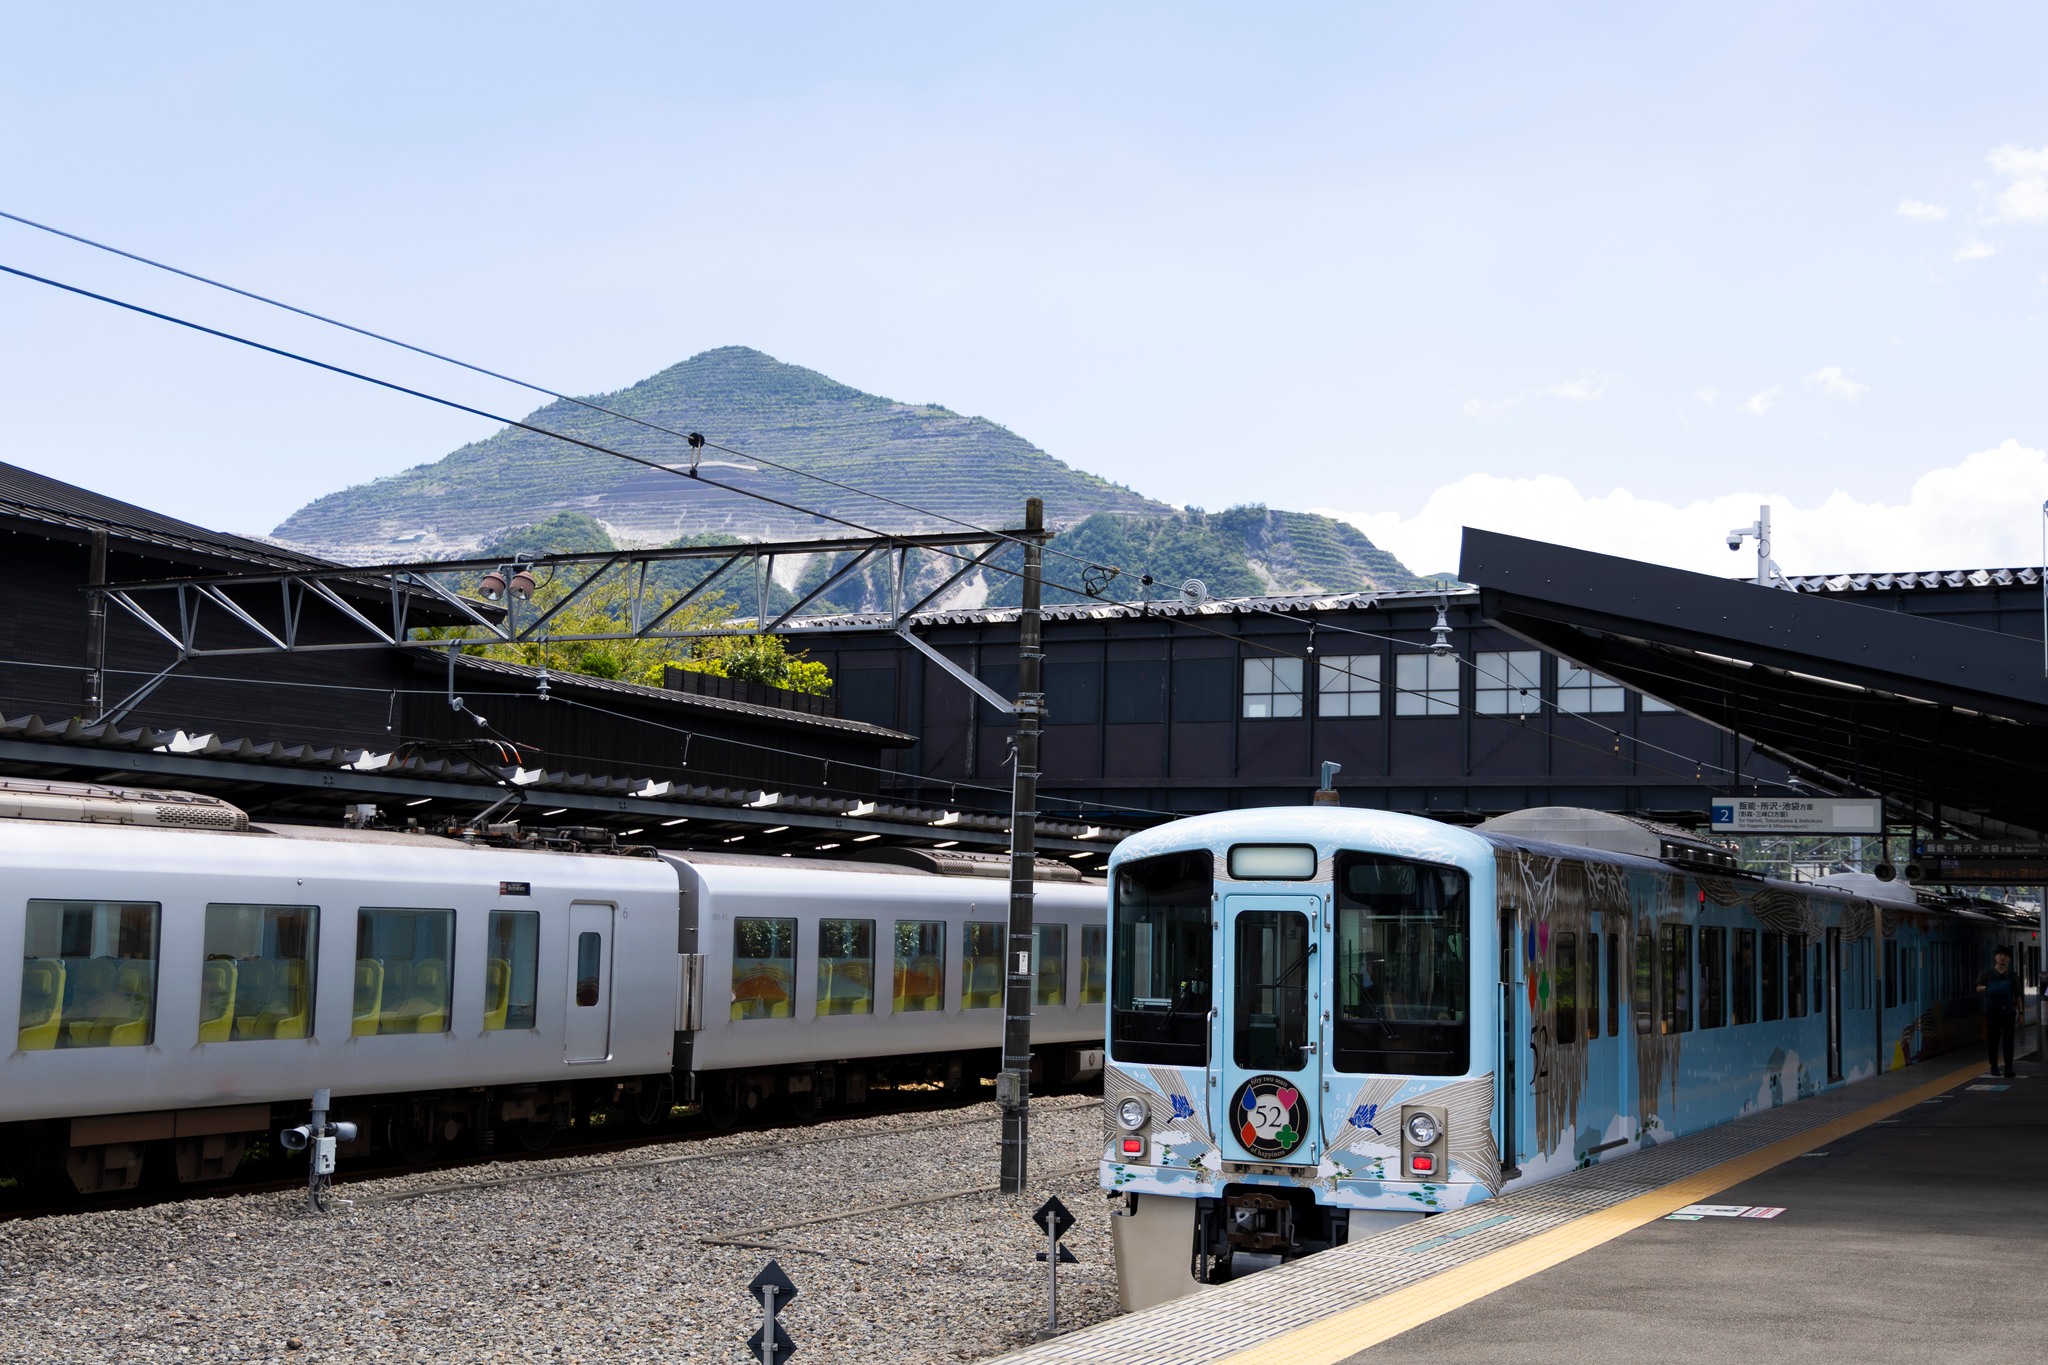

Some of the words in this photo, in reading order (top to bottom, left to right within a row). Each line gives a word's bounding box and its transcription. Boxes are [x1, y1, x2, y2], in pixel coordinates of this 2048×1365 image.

[1739, 801, 1814, 810] 飯能・所沢・池袋方面
[1720, 809, 1729, 822] 2
[622, 907, 629, 920] 6
[1530, 1025, 1549, 1086] 52
[1250, 1077, 1262, 1086] fifty
[1275, 1078, 1288, 1087] seats
[1256, 1105, 1282, 1129] 52
[1257, 1149, 1286, 1159] happiness
